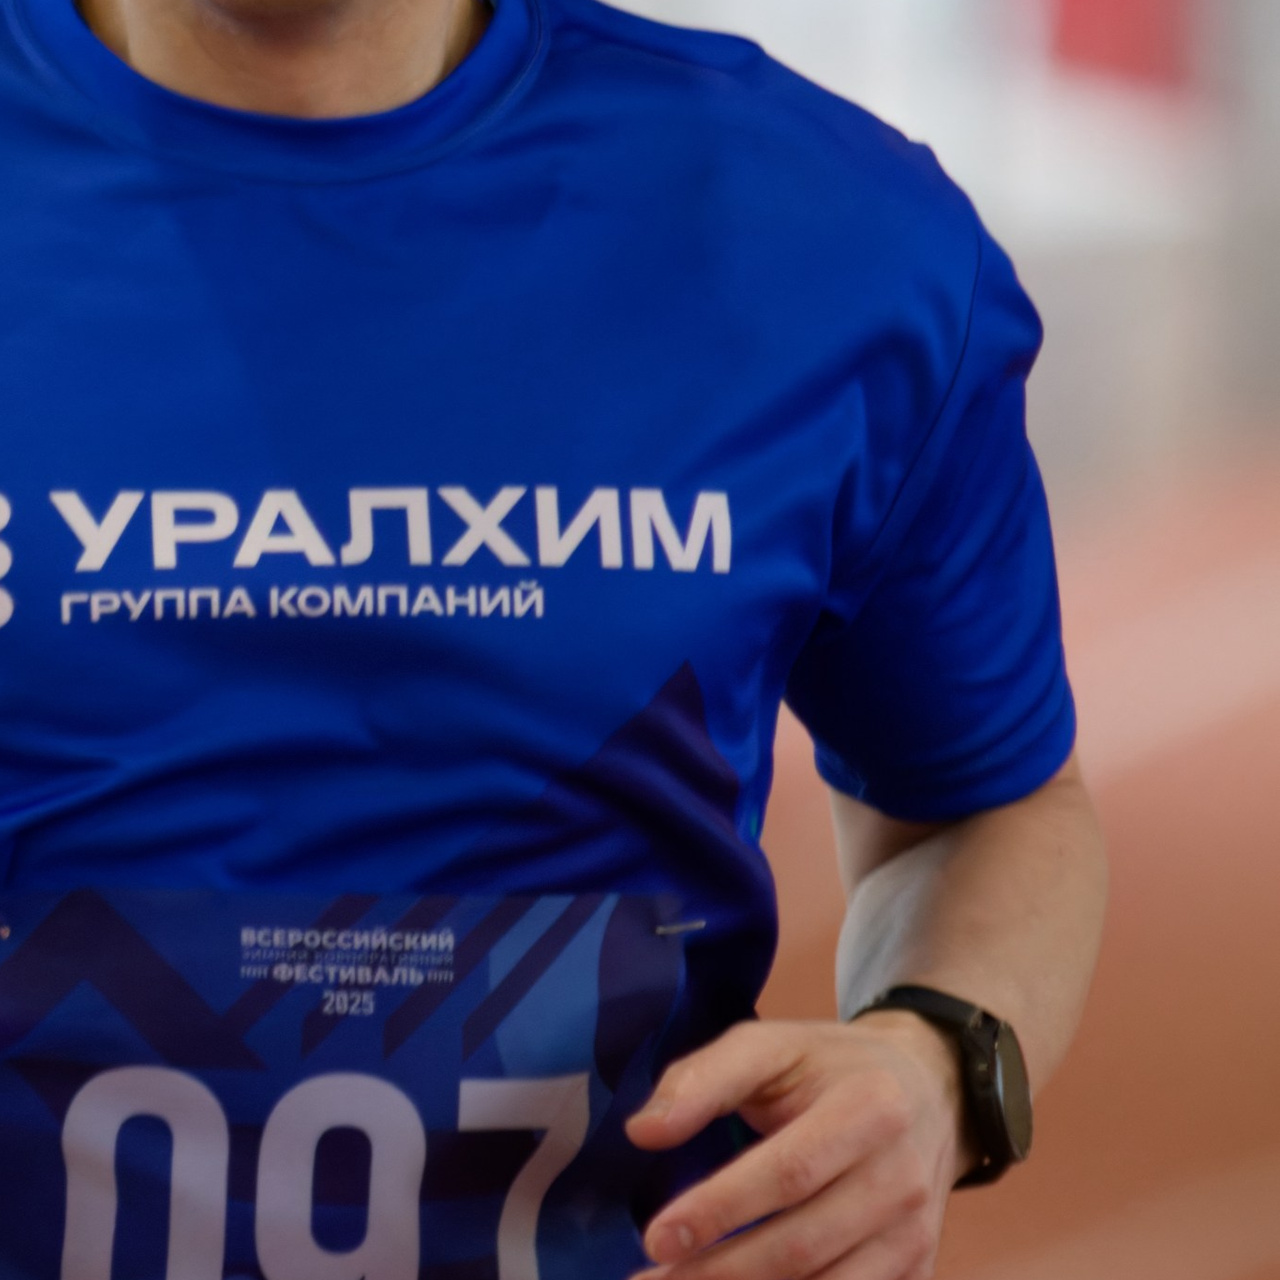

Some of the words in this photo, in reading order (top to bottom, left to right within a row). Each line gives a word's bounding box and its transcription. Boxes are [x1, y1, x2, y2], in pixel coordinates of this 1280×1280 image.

[49, 485, 732, 574] УРАЛХИМ
[61, 585, 257, 624] ГРУППА
[270, 580, 545, 619] КОМПАНИЙ
[240, 926, 455, 952] ВСЕРОССИЙСКИЙ
[272, 963, 425, 987] ФЕСТИВАЛЬ
[322, 990, 376, 1015] 2025
